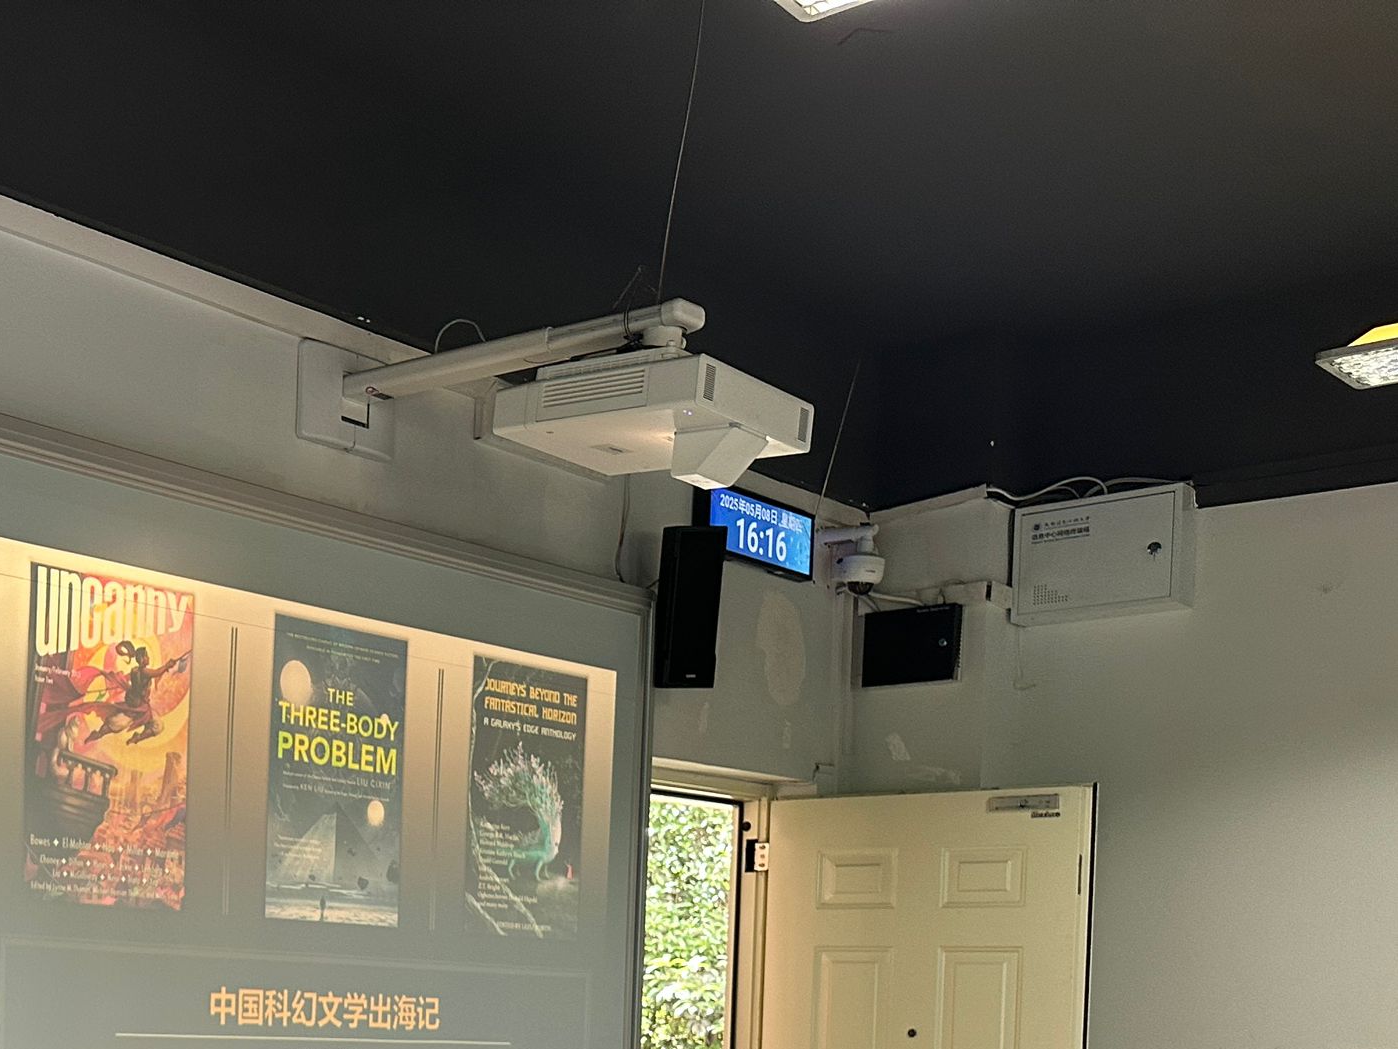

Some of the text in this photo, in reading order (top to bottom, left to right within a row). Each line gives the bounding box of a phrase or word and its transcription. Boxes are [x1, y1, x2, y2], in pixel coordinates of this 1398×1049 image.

[720, 494, 778, 526] 2025年05月08日
[736, 518, 787, 562] 16:16
[35, 565, 191, 657] uncanny
[327, 687, 355, 707] THE
[484, 696, 577, 725] FANTASTICAL HORIZON
[529, 686, 560, 703] BEYOND
[563, 693, 578, 707] THE
[278, 700, 399, 741] THREE-BODY
[484, 717, 489, 726] A
[523, 724, 539, 735] EDGE
[541, 727, 576, 741] ANTHOLOGY
[277, 730, 398, 776] PROBLEM
[209, 986, 441, 1031] 中国科幻文学出海记
